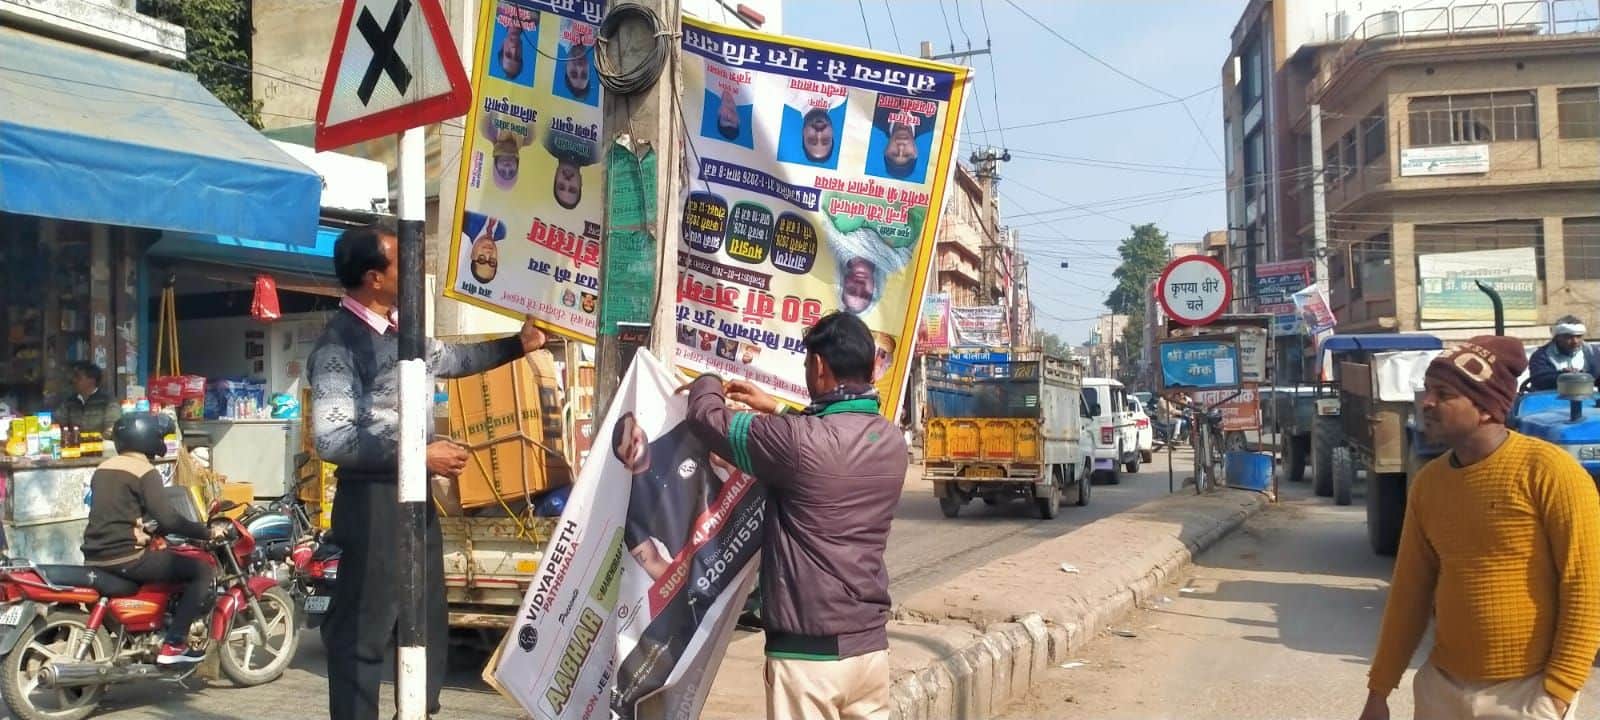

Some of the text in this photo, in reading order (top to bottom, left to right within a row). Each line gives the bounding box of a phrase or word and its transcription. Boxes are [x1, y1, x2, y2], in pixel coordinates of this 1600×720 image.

[850, 61, 937, 94] सौजन्य
[866, 204, 883, 221] देवी
[728, 237, 763, 260] भण्डारा
[773, 250, 806, 271] जागरण
[526, 257, 552, 275] जय
[551, 264, 573, 285] की
[1169, 281, 1197, 298] कृपया
[778, 292, 823, 327] 50
[1185, 295, 1203, 311] चले
[703, 472, 751, 534] PATHSHALA
[528, 519, 578, 621] VIDYAPEETH
[543, 541, 580, 613] PATHSHALA
[545, 606, 604, 716] AABHAR
[597, 668, 612, 695] JEE
